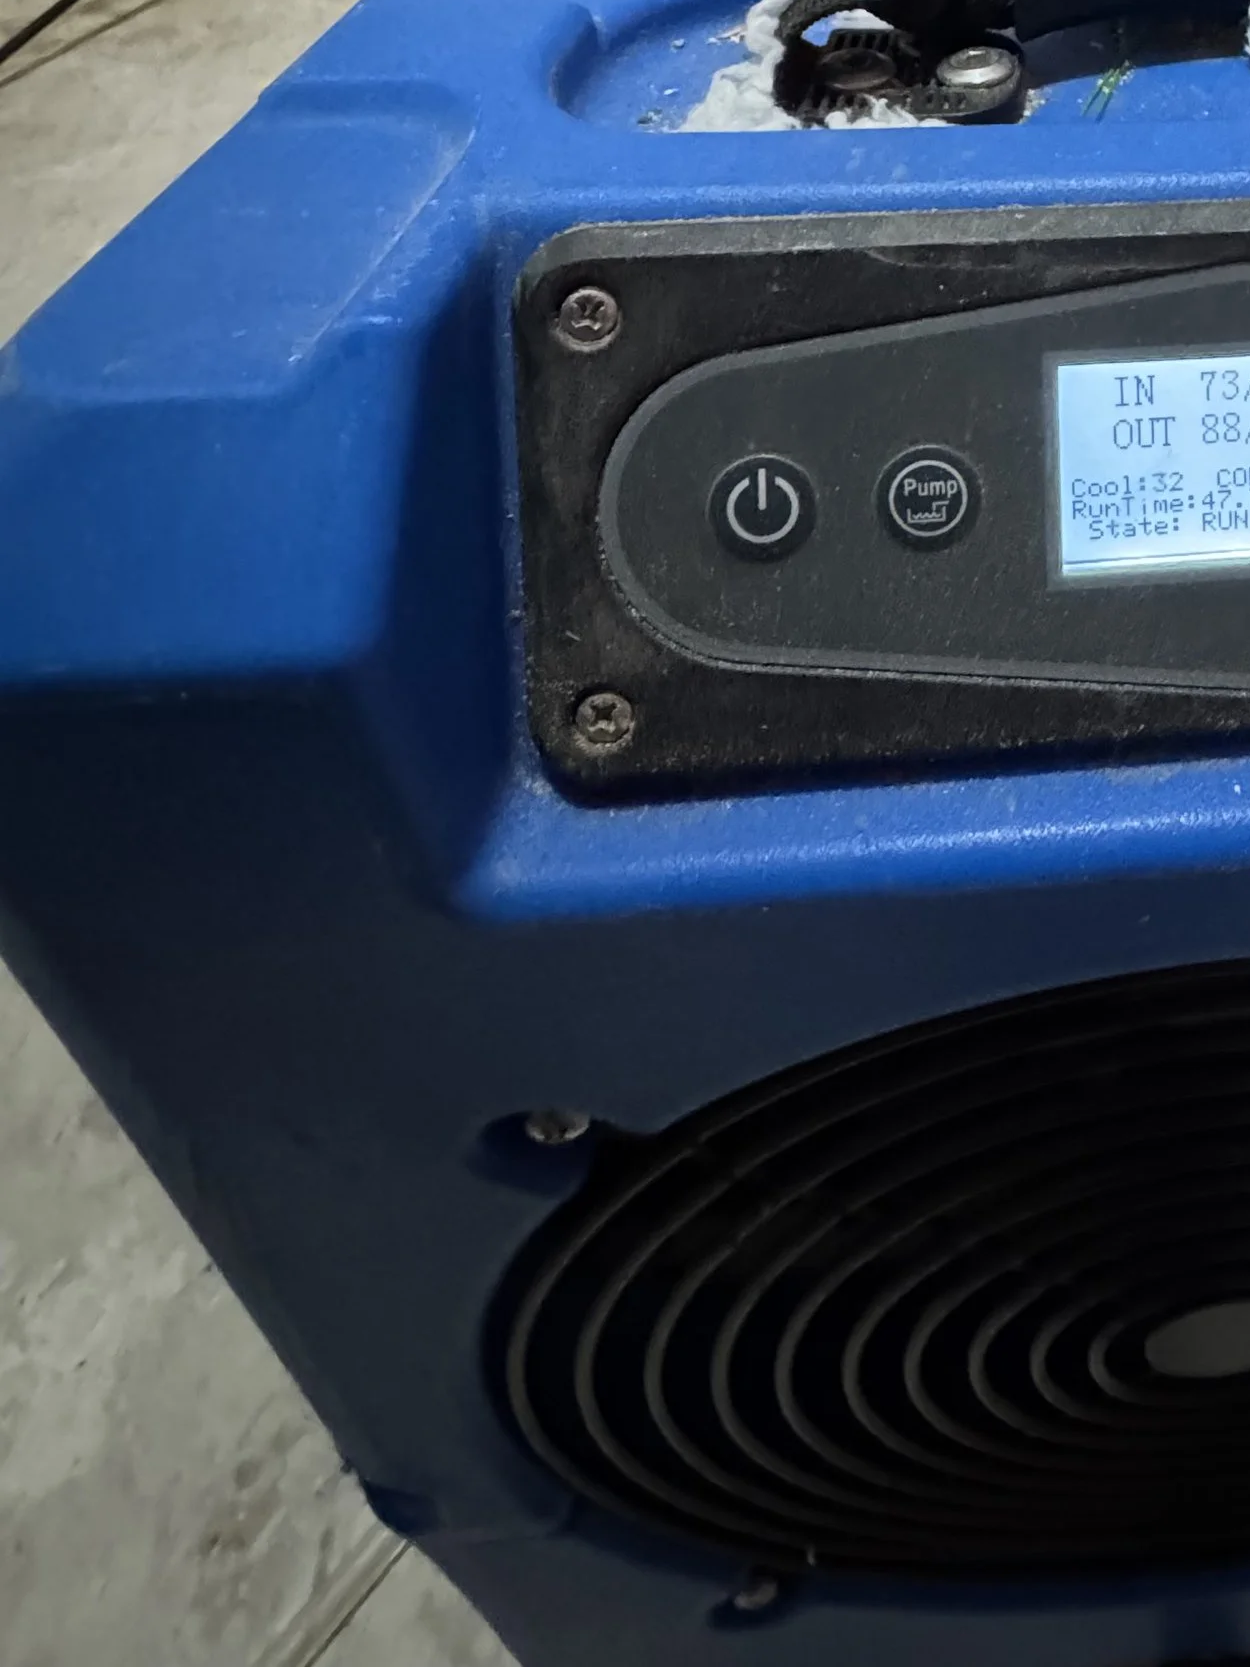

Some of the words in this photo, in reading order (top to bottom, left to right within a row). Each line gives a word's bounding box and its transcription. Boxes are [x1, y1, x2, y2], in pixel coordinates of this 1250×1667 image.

[1114, 374, 1155, 407] IN
[1113, 416, 1176, 450] OUT
[902, 477, 959, 499] Pump
[1071, 470, 1184, 499] Cool:32
[1088, 516, 1180, 541] State:
[1201, 508, 1249, 533] RUN
